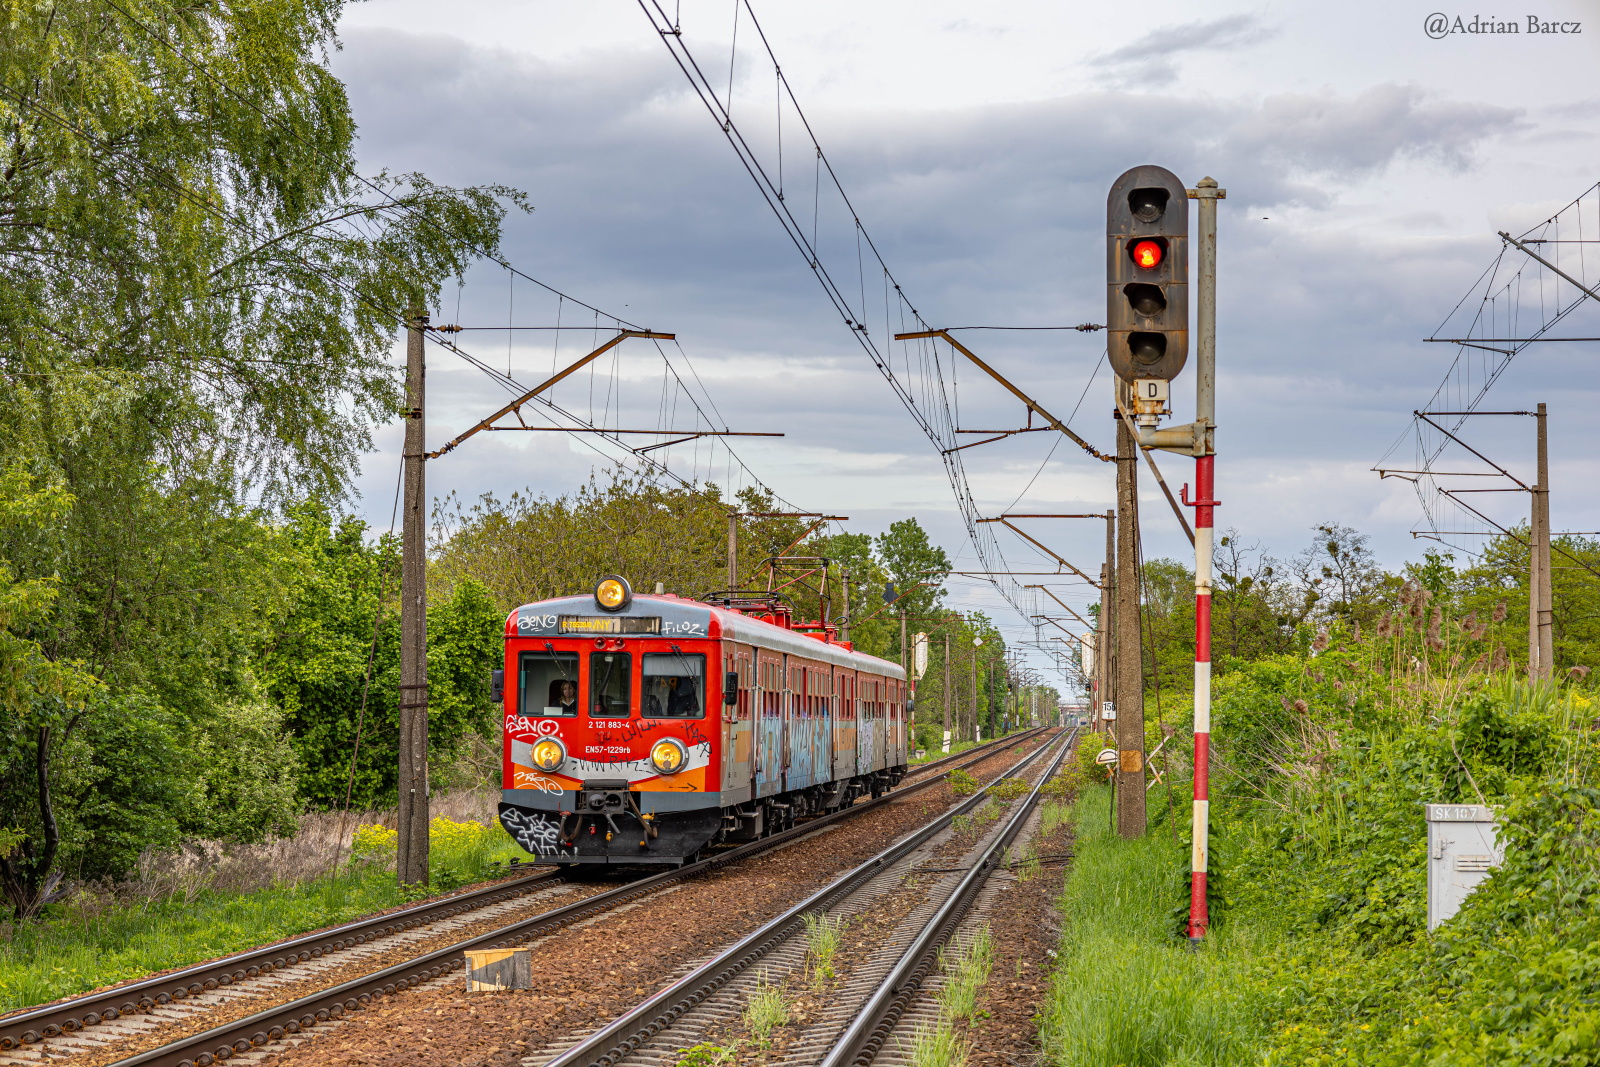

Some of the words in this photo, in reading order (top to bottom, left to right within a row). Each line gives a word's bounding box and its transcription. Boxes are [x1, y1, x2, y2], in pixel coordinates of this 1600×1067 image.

[1149, 383, 1157, 397] D
[585, 745, 631, 753] EN57-1229rb
[1435, 808, 1451, 820] SK
[1455, 808, 1477, 820] 107
